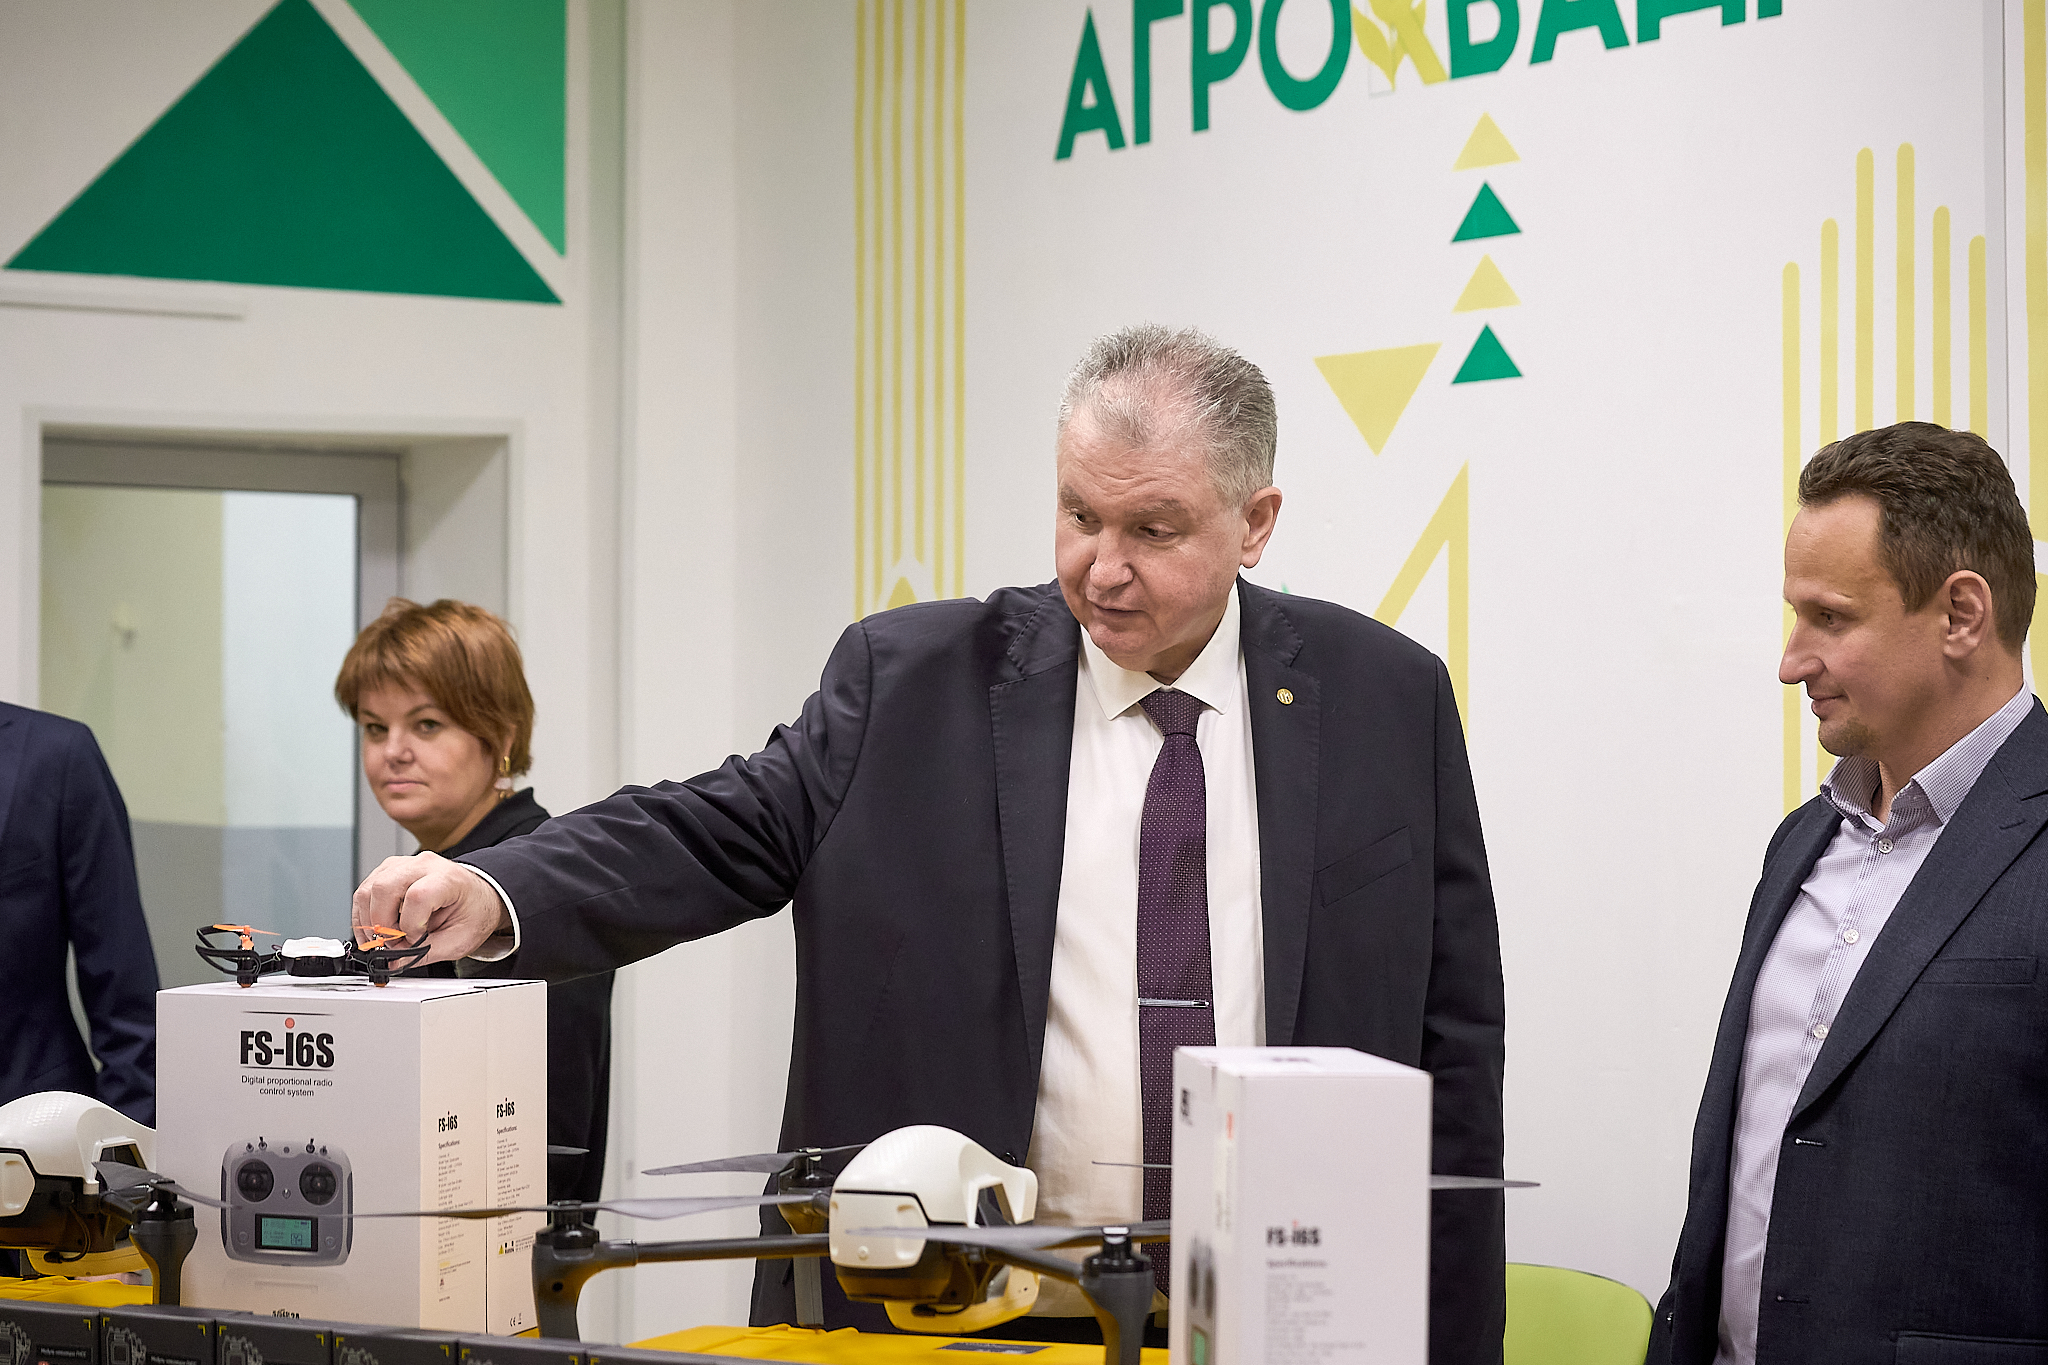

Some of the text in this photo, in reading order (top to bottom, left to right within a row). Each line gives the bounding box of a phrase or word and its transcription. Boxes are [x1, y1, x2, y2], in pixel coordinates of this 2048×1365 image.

[240, 1017, 335, 1068] FS-i6S
[241, 1075, 333, 1087] Digital proportional radio
[259, 1087, 315, 1098] control system
[496, 1097, 515, 1118] FS-i6S
[438, 1110, 458, 1133] FS-i6S
